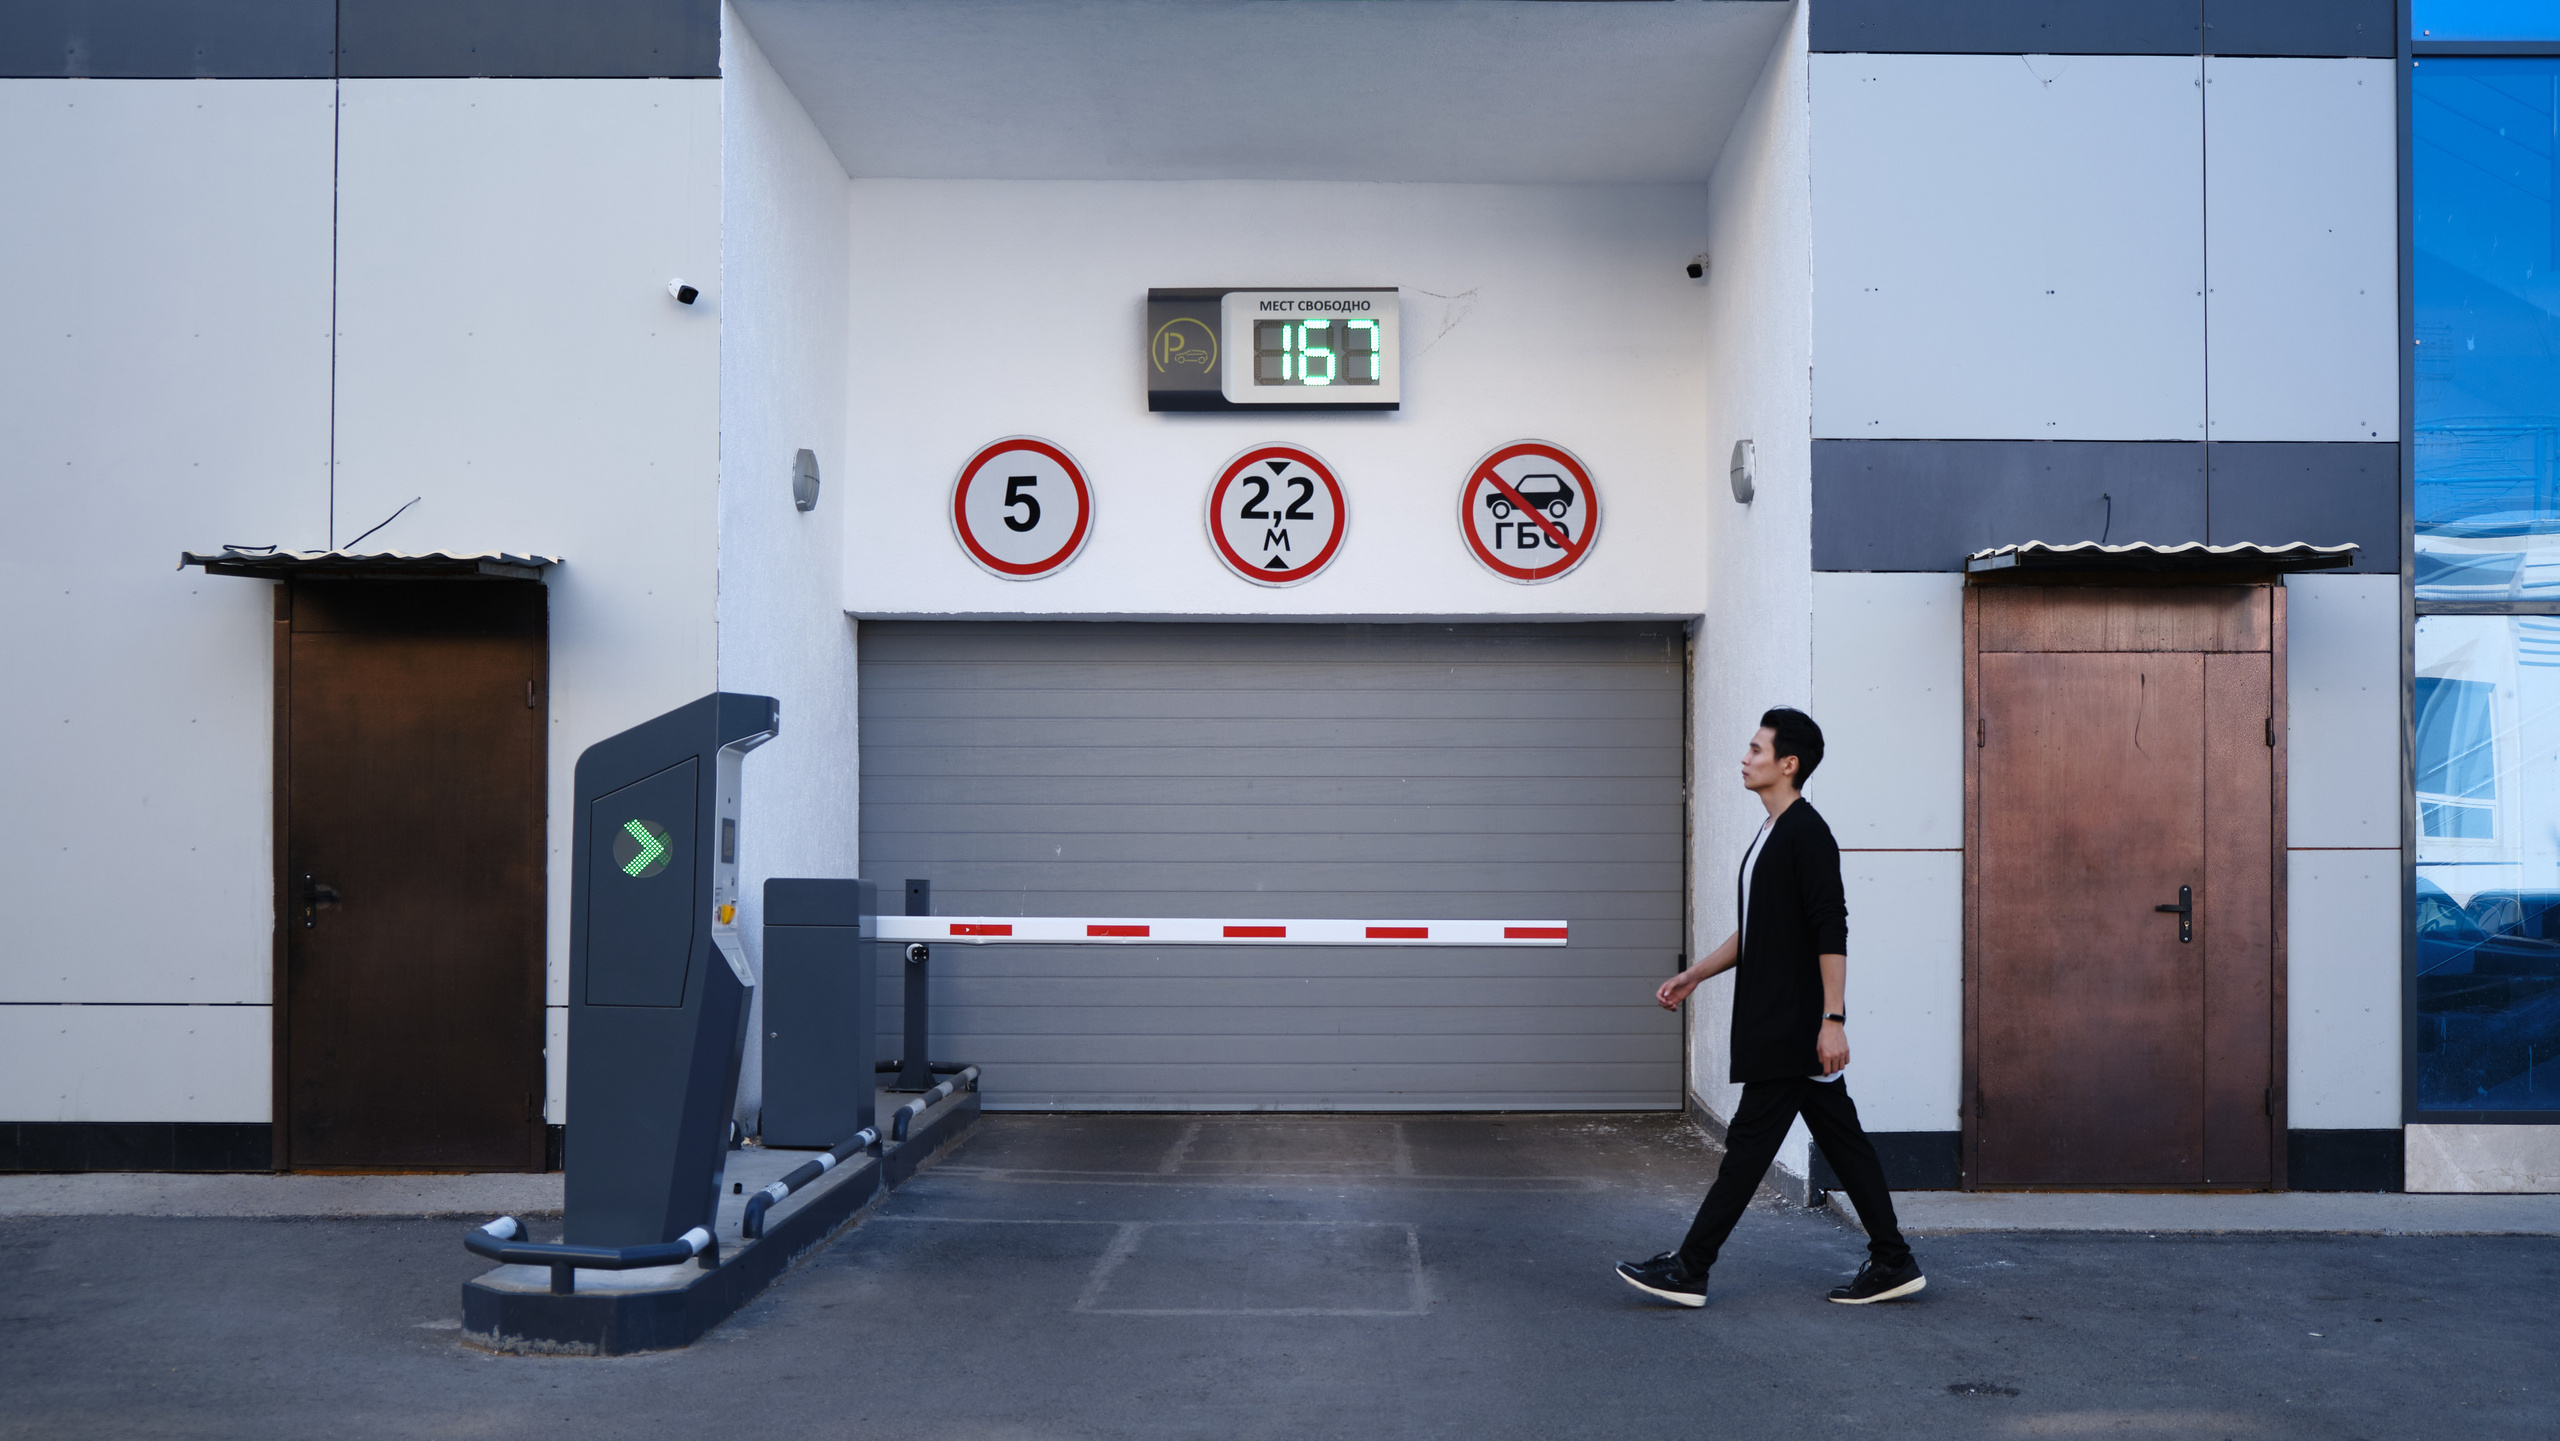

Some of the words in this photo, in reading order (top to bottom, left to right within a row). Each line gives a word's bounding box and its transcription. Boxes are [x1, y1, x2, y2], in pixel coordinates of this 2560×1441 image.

[1260, 300, 1293, 312] МЕСТ
[1298, 300, 1371, 313] СВОБОДНО
[1164, 332, 1185, 364] P
[1282, 319, 1380, 386] 167
[1004, 476, 1041, 533] 5
[1241, 476, 1314, 528] 2,2
